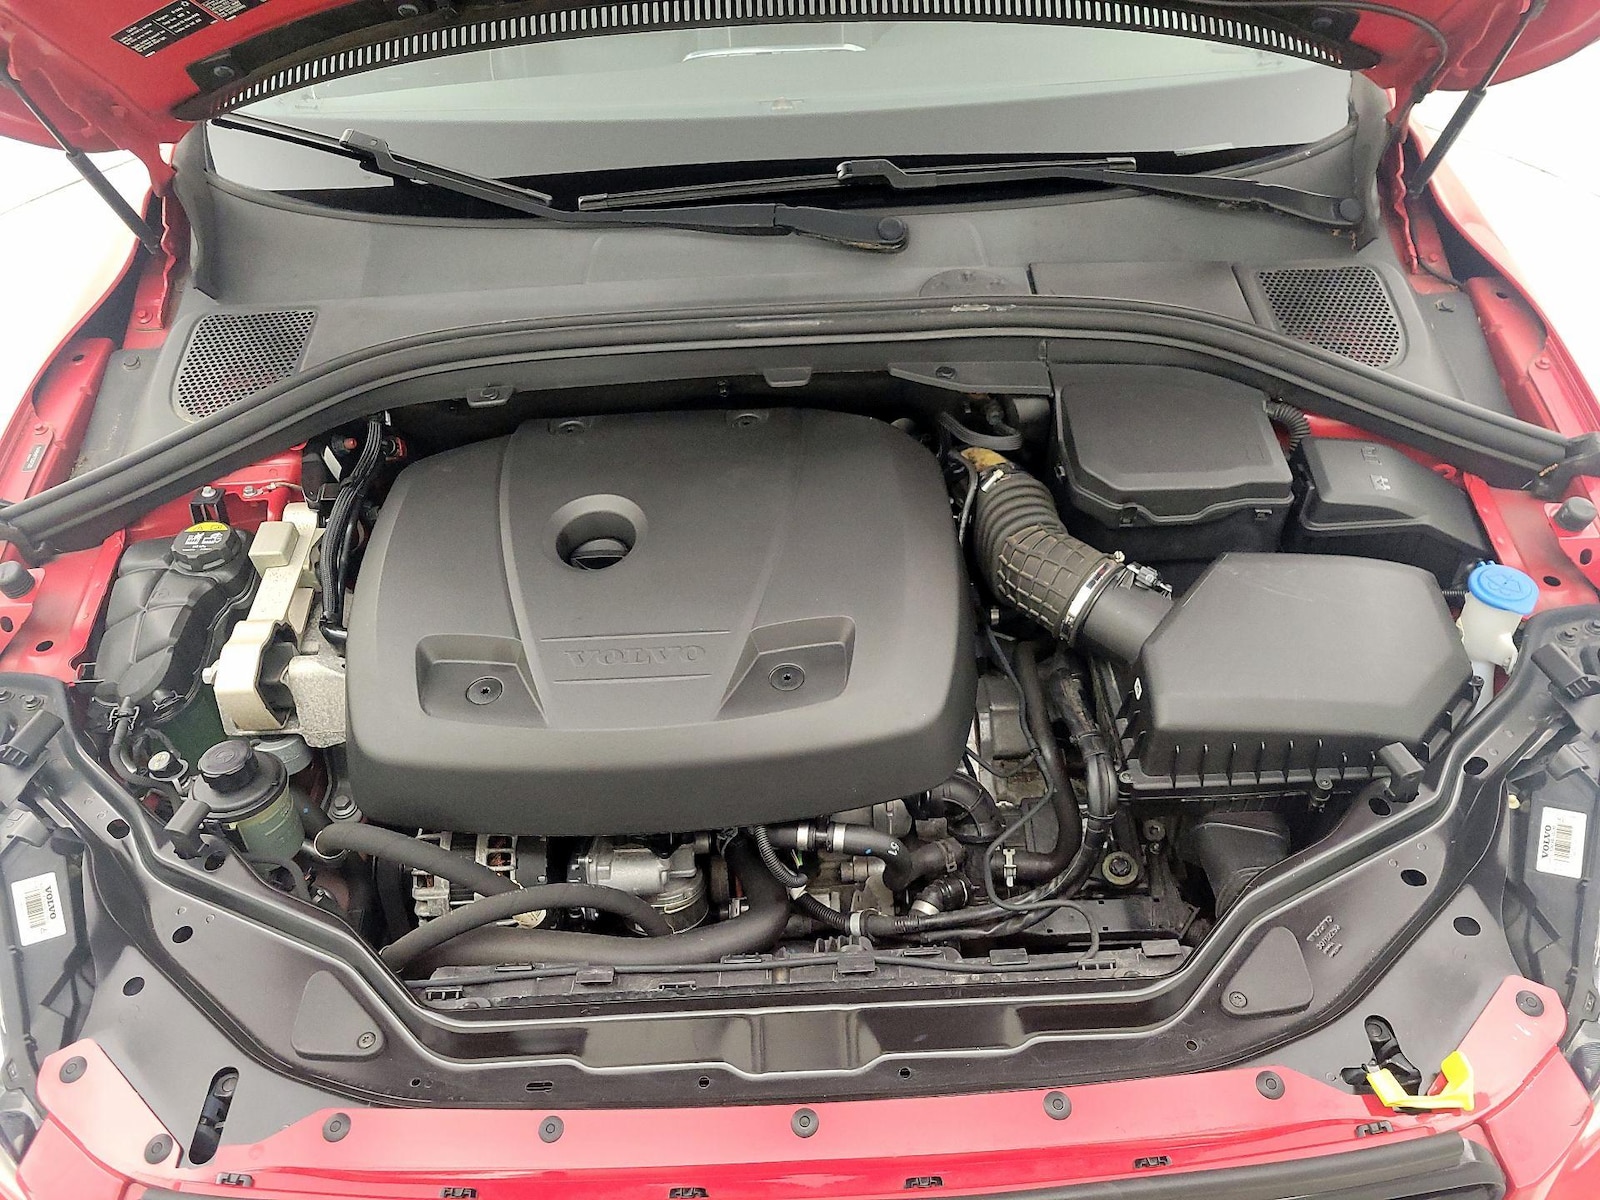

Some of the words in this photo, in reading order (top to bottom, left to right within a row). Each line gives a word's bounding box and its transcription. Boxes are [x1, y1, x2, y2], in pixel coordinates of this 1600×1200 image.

[563, 645, 706, 669] VOLVO
[1541, 824, 1552, 859] VOLVO
[45, 885, 57, 920] VOLVO
